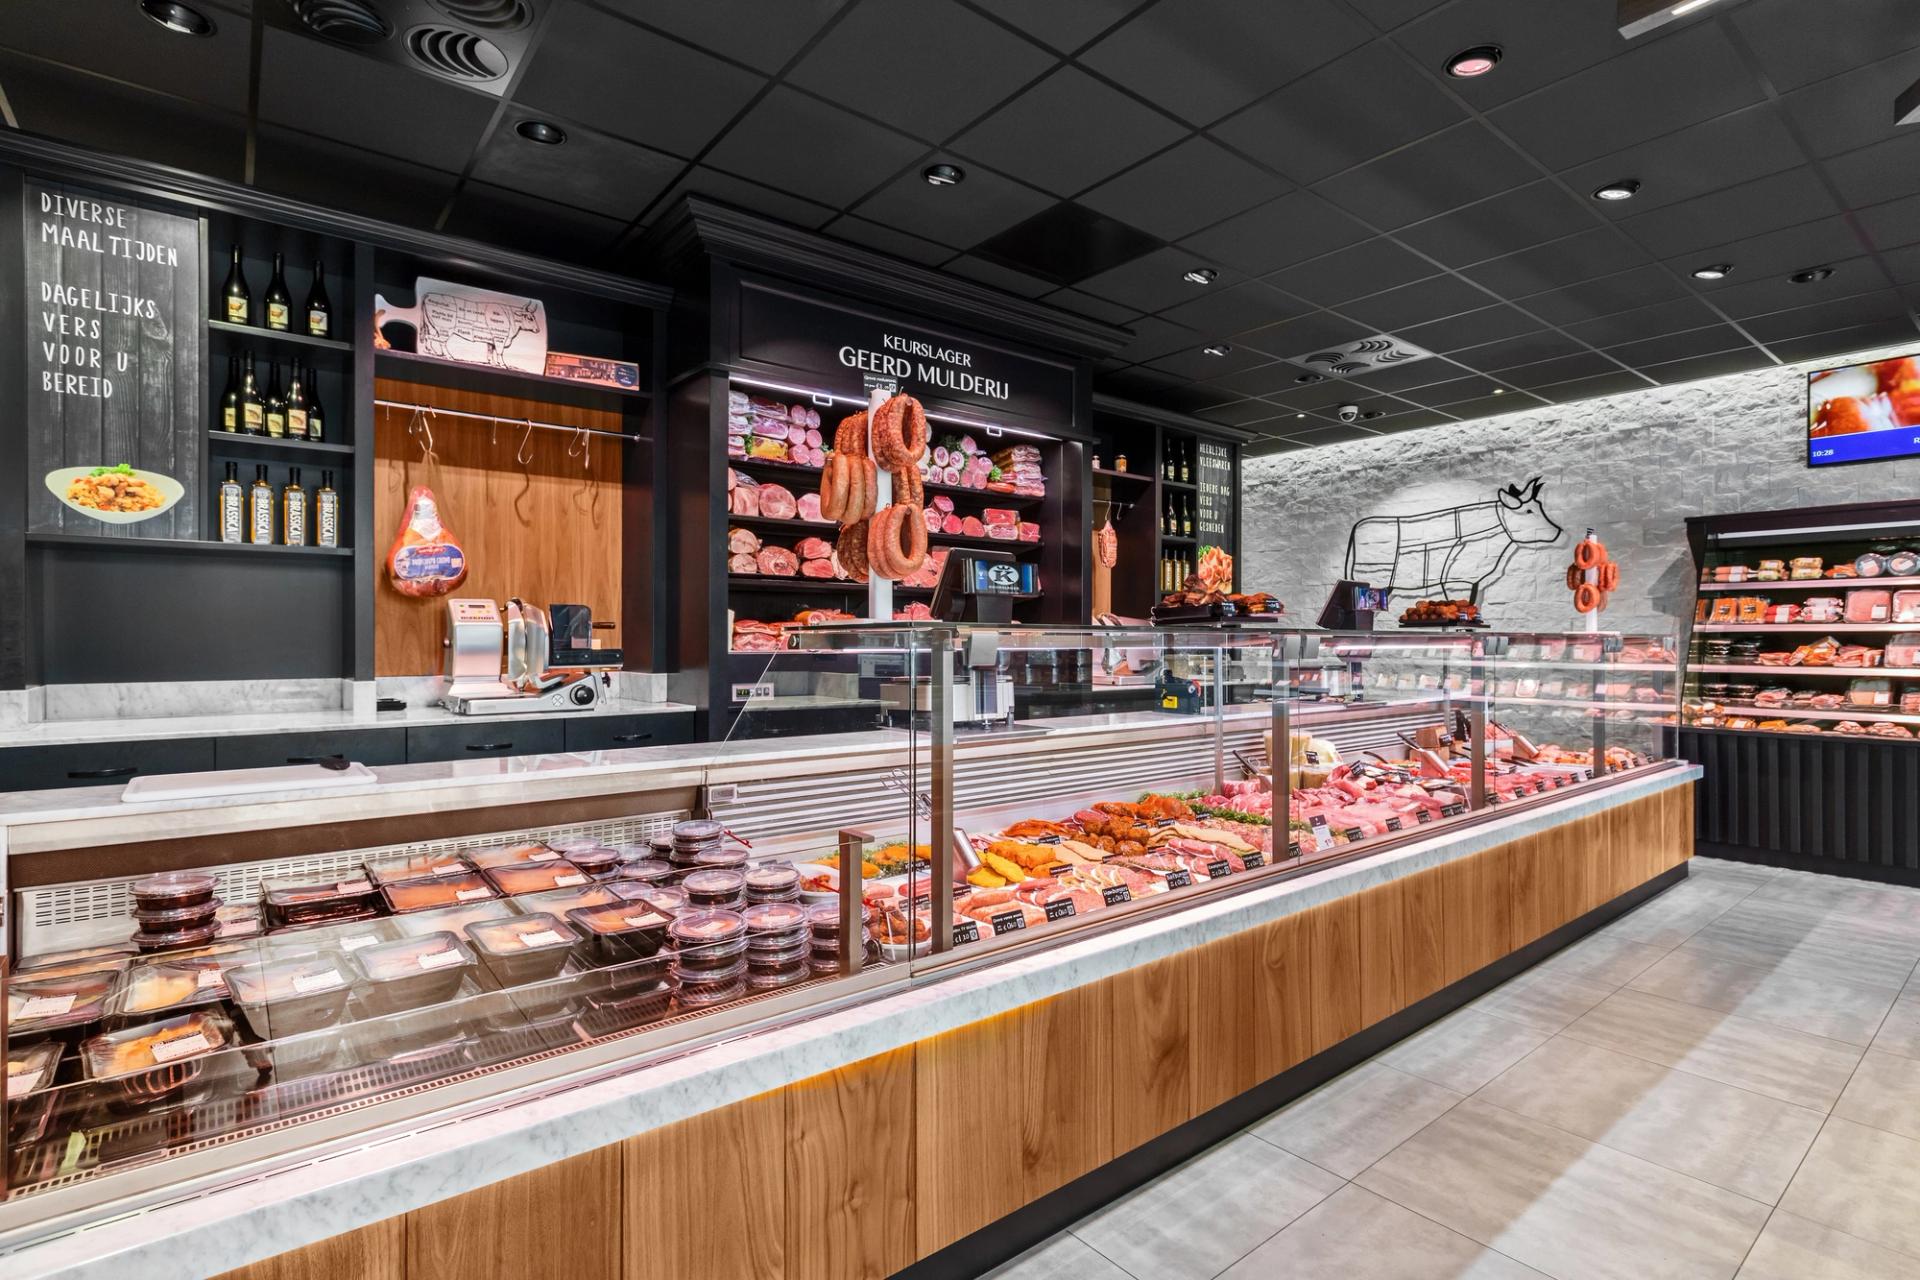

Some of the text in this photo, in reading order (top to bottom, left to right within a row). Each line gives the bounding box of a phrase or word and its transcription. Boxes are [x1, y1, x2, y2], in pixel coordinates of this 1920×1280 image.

[41, 192, 127, 229] DIVERSE
[41, 280, 157, 320] DAGELIJKS
[42, 311, 101, 340] VERS
[42, 341, 128, 372] VOOR U
[883, 334, 971, 368] KEURSLAGER
[42, 370, 113, 399] BEREID
[838, 346, 1009, 400] GEERD MULDERIJ
[1812, 449, 1834, 457] 10:28
[225, 495, 240, 535] BRASSICA
[256, 498, 270, 535] BRASSICA
[1199, 495, 1213, 506] VERS
[1199, 508, 1213, 520] VOOR
[288, 501, 302, 539] BRASSICA
[322, 503, 335, 541] BRASSICA
